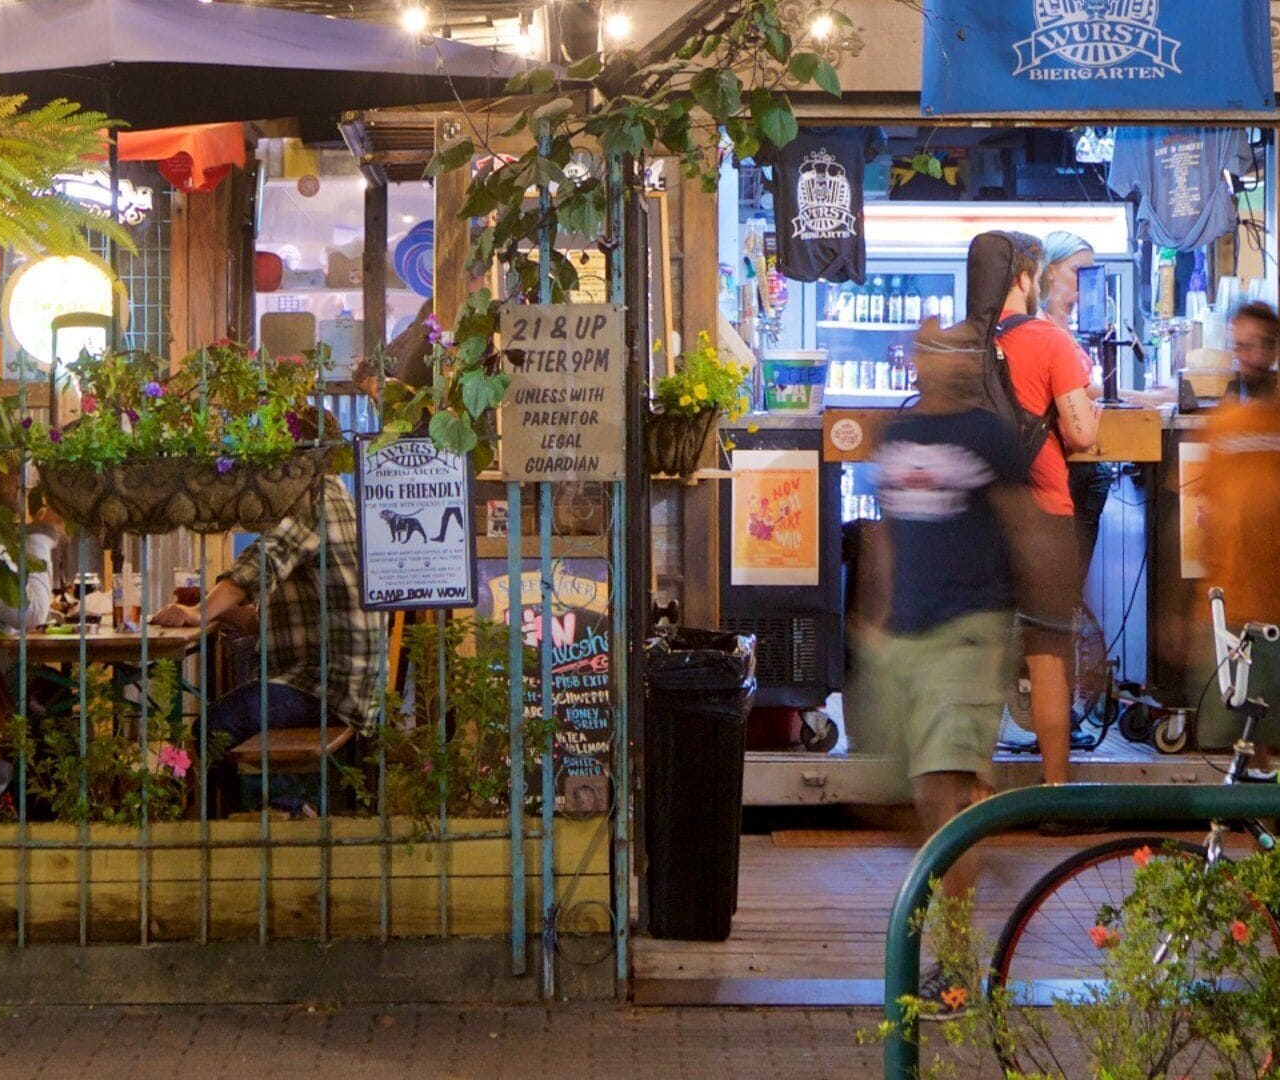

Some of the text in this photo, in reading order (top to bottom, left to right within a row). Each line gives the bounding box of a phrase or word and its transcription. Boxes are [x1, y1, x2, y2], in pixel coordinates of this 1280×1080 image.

[1037, 22, 1157, 50] WURST
[1029, 67, 1166, 80] BIERGARTEN
[799, 206, 848, 220] WURST
[512, 314, 607, 341] 21 & UP
[572, 347, 610, 373] 9PM
[515, 386, 605, 405] UNLESS WITH
[522, 410, 599, 427] PARENT OR
[540, 433, 583, 450] LEGAL
[375, 468, 450, 477] BIERGARTEN
[524, 456, 600, 474] GUARDIAN
[365, 481, 462, 501] DOG FRIENDLY
[368, 587, 466, 601] CAMP BOW WOW
